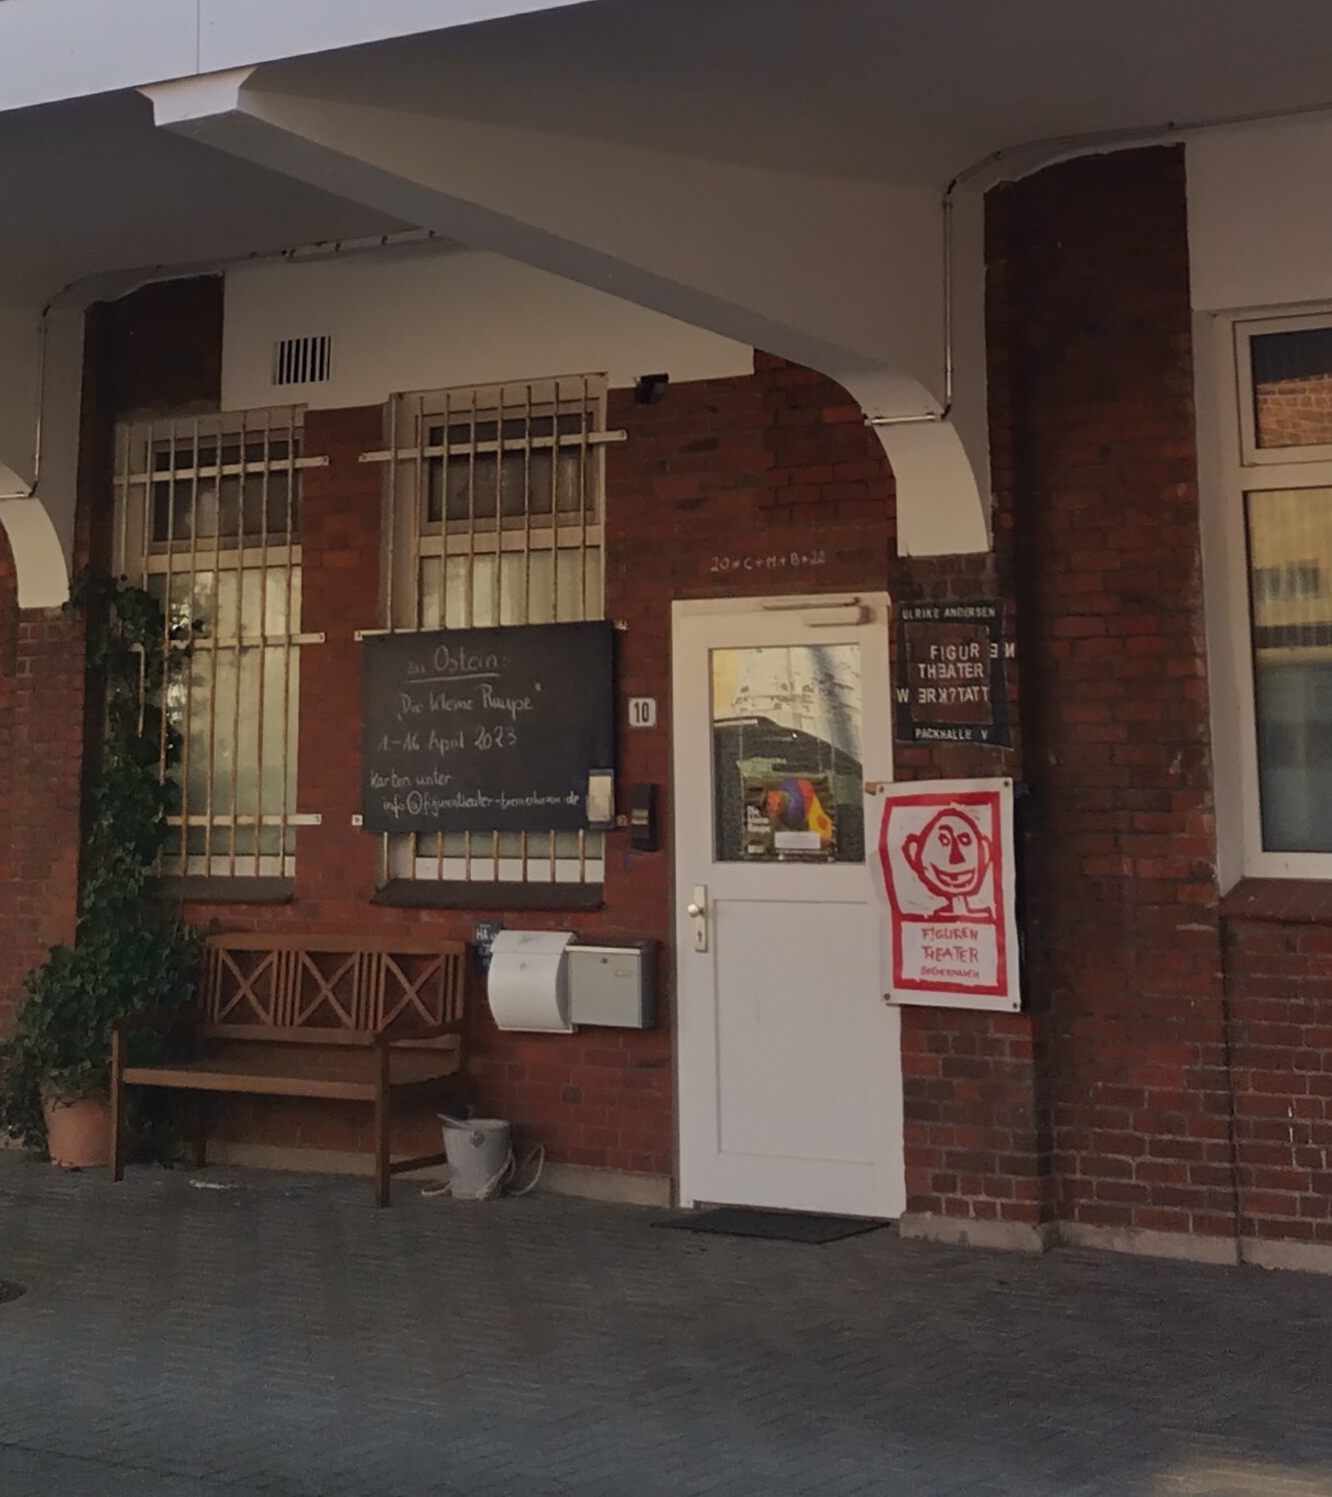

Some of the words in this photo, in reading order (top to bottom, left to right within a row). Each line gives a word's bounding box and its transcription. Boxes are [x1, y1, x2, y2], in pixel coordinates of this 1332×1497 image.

[902, 607, 940, 620] ULRIKE
[944, 606, 995, 619] ANDERSEN
[917, 662, 985, 679] THEATER
[634, 702, 650, 724] 10
[428, 730, 465, 757] April
[474, 725, 517, 751] 2023
[915, 727, 972, 741] PACKHALLE
[981, 728, 989, 741] V
[416, 765, 453, 787] unter
[922, 945, 979, 963] THEATER
